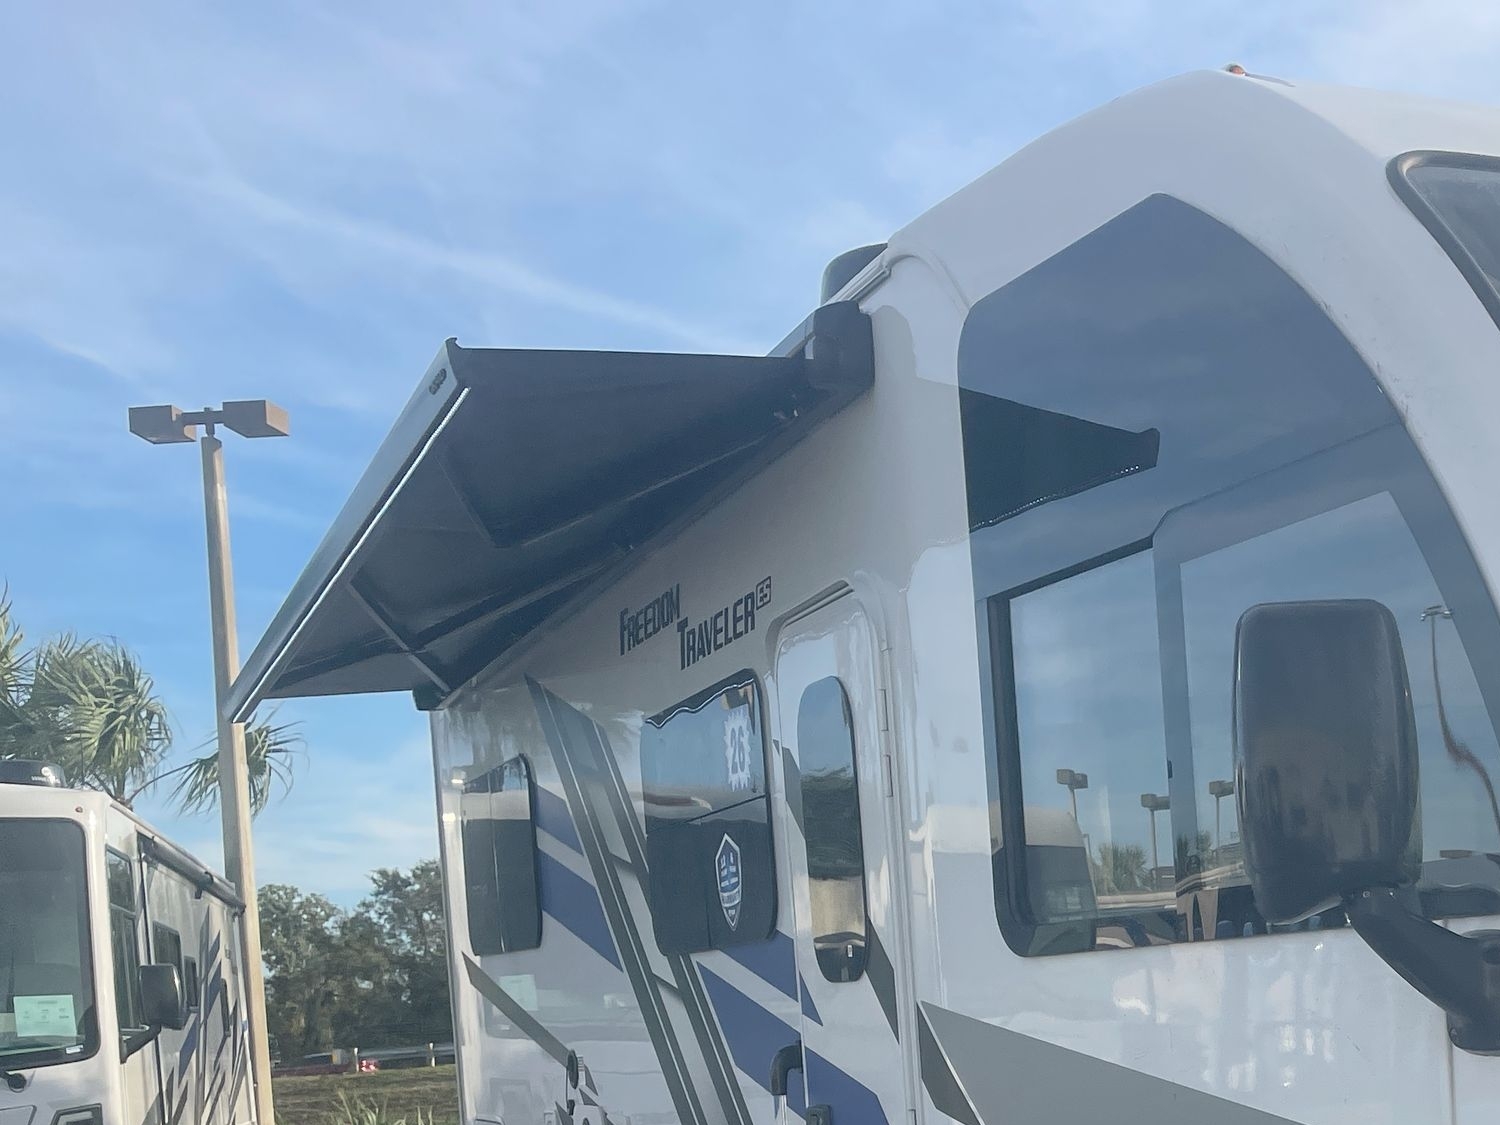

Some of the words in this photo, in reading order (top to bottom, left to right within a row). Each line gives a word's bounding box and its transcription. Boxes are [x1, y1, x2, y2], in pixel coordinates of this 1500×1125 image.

[620, 583, 681, 656] FREEDOM
[677, 591, 756, 670] TRAVELER
[730, 726, 746, 775] 26
